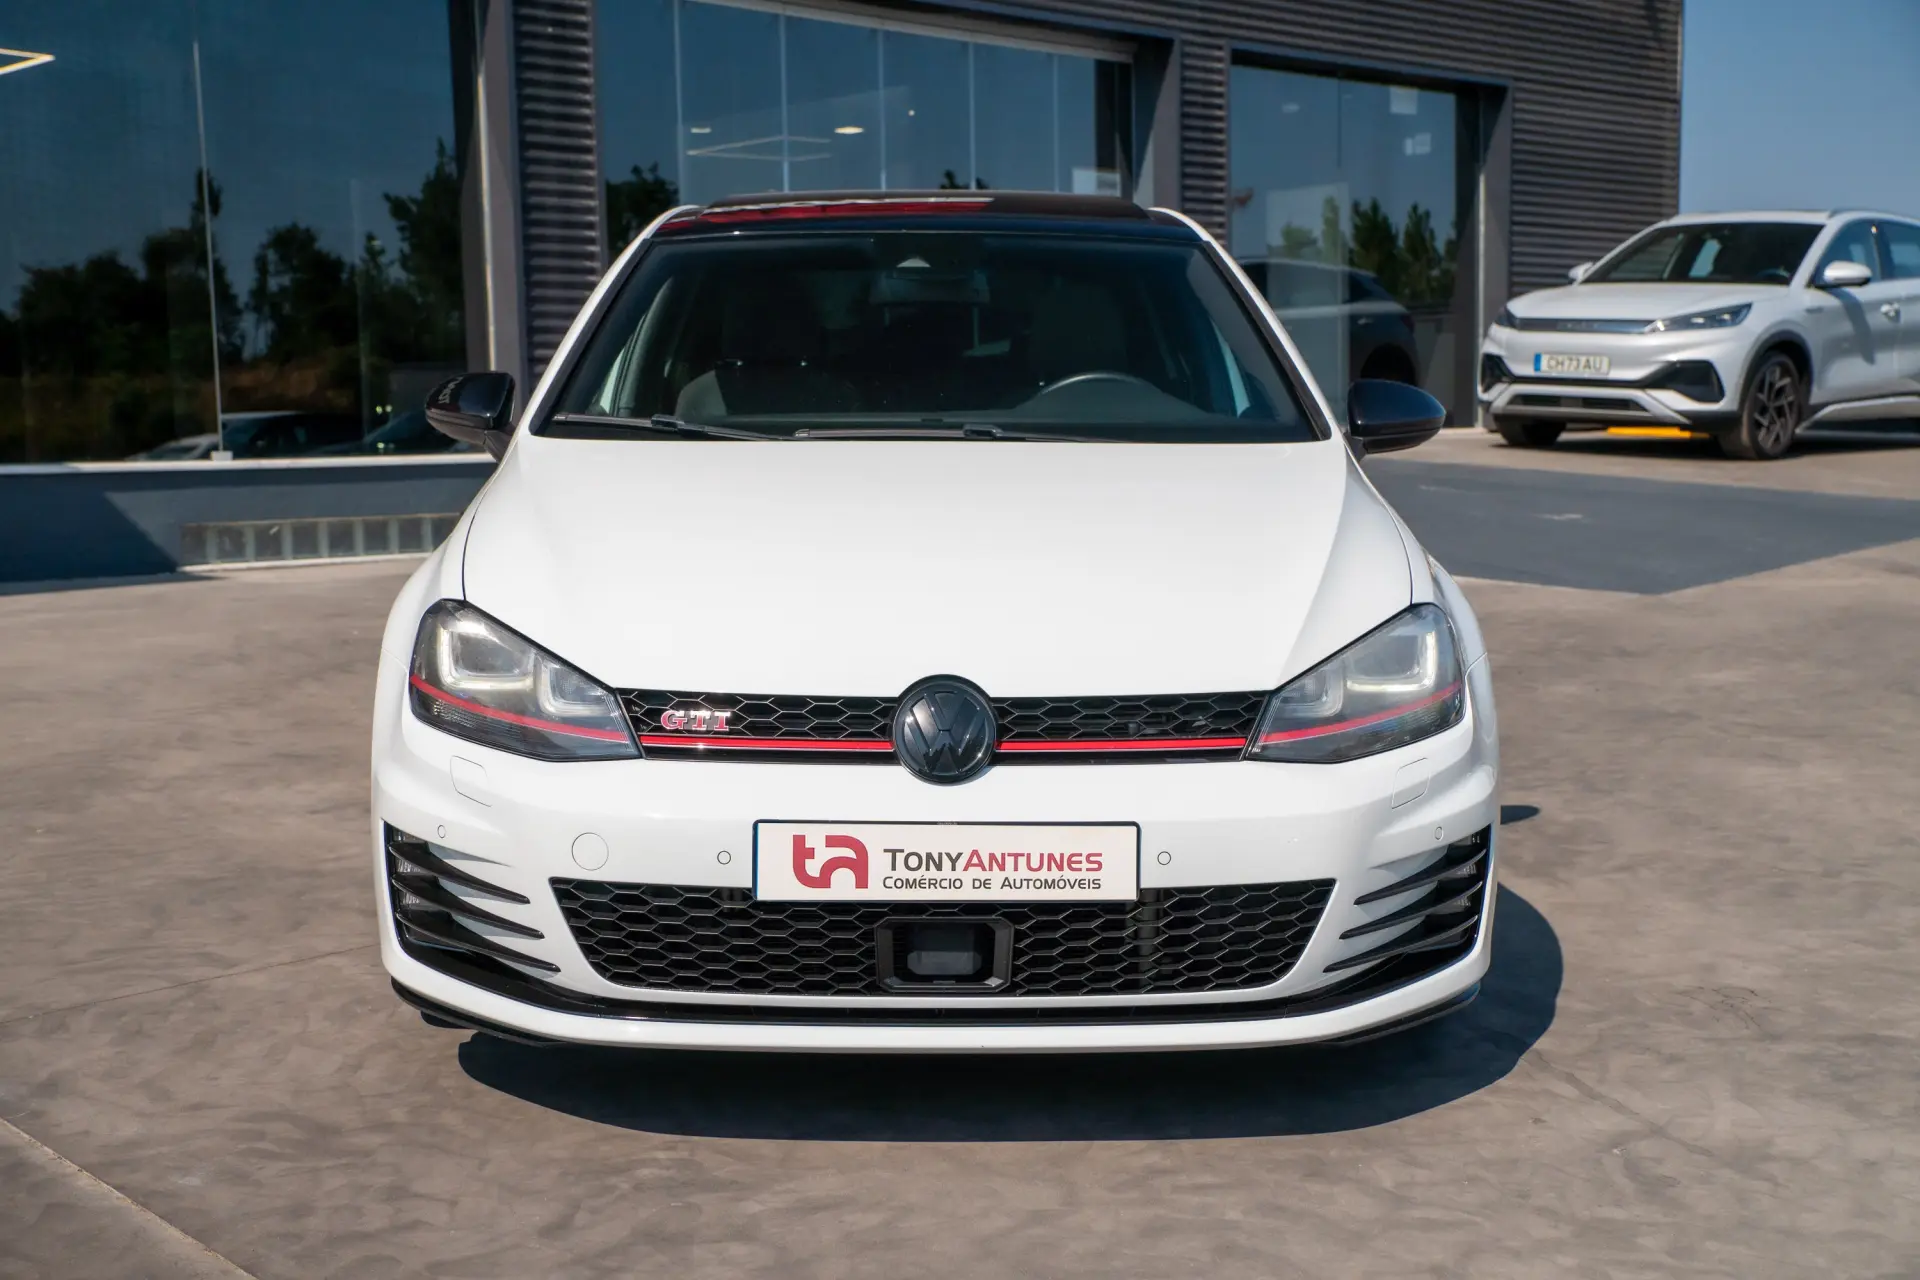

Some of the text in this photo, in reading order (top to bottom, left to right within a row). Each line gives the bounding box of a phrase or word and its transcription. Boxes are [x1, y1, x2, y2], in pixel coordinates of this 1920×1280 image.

[660, 709, 731, 731] GTI
[882, 875, 1102, 890] COMÉRCIO DE AUTOMÓVEIS
